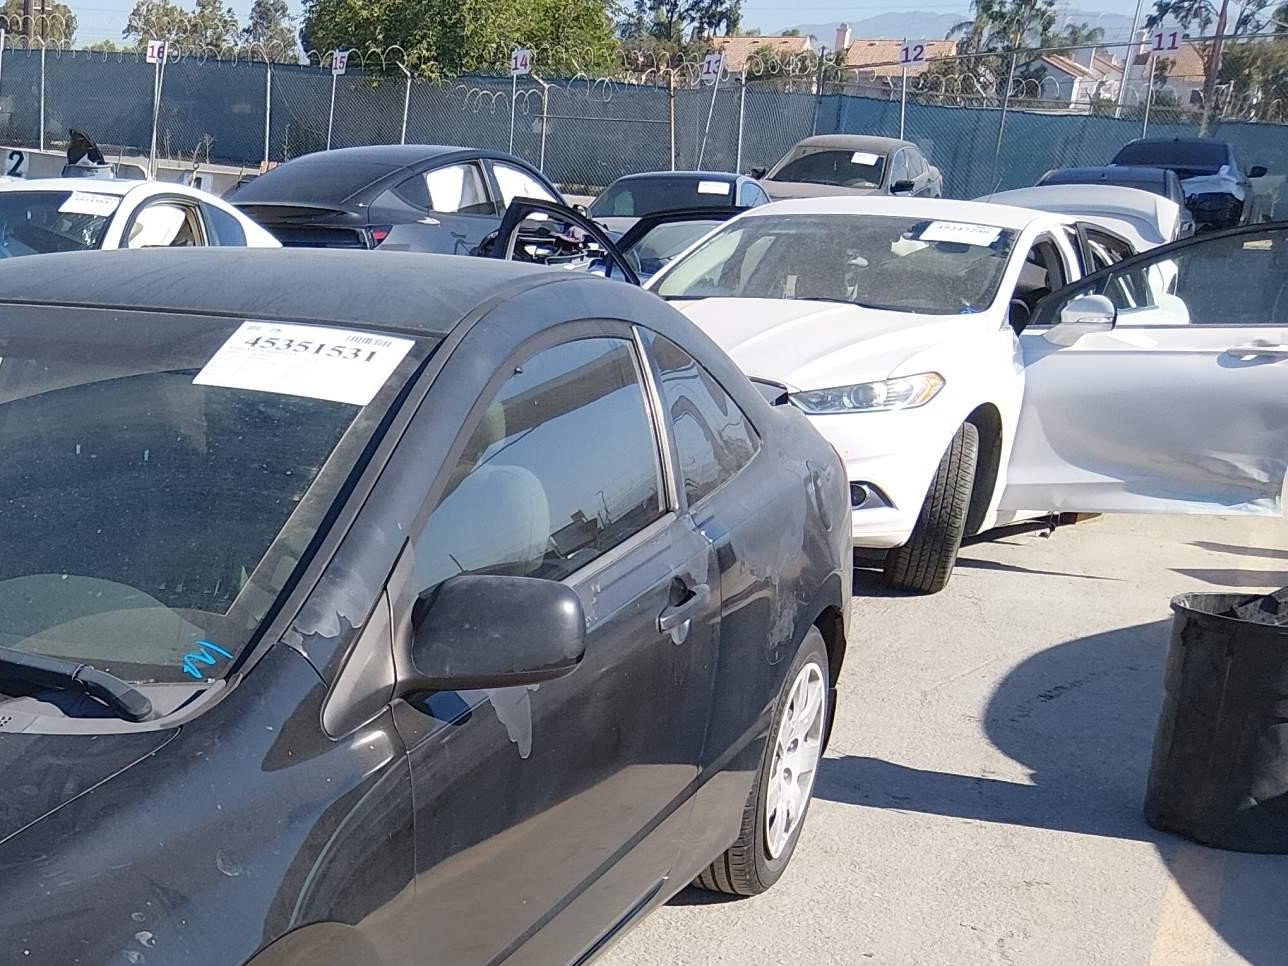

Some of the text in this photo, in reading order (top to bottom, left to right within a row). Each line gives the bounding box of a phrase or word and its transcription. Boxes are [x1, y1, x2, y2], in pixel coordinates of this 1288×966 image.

[1152, 31, 1179, 51] 11
[333, 55, 347, 71] 15
[511, 53, 529, 71] 14
[900, 44, 925, 64] 12
[702, 58, 721, 75] 13
[6, 150, 25, 178] 2
[243, 336, 378, 363] 45351531
